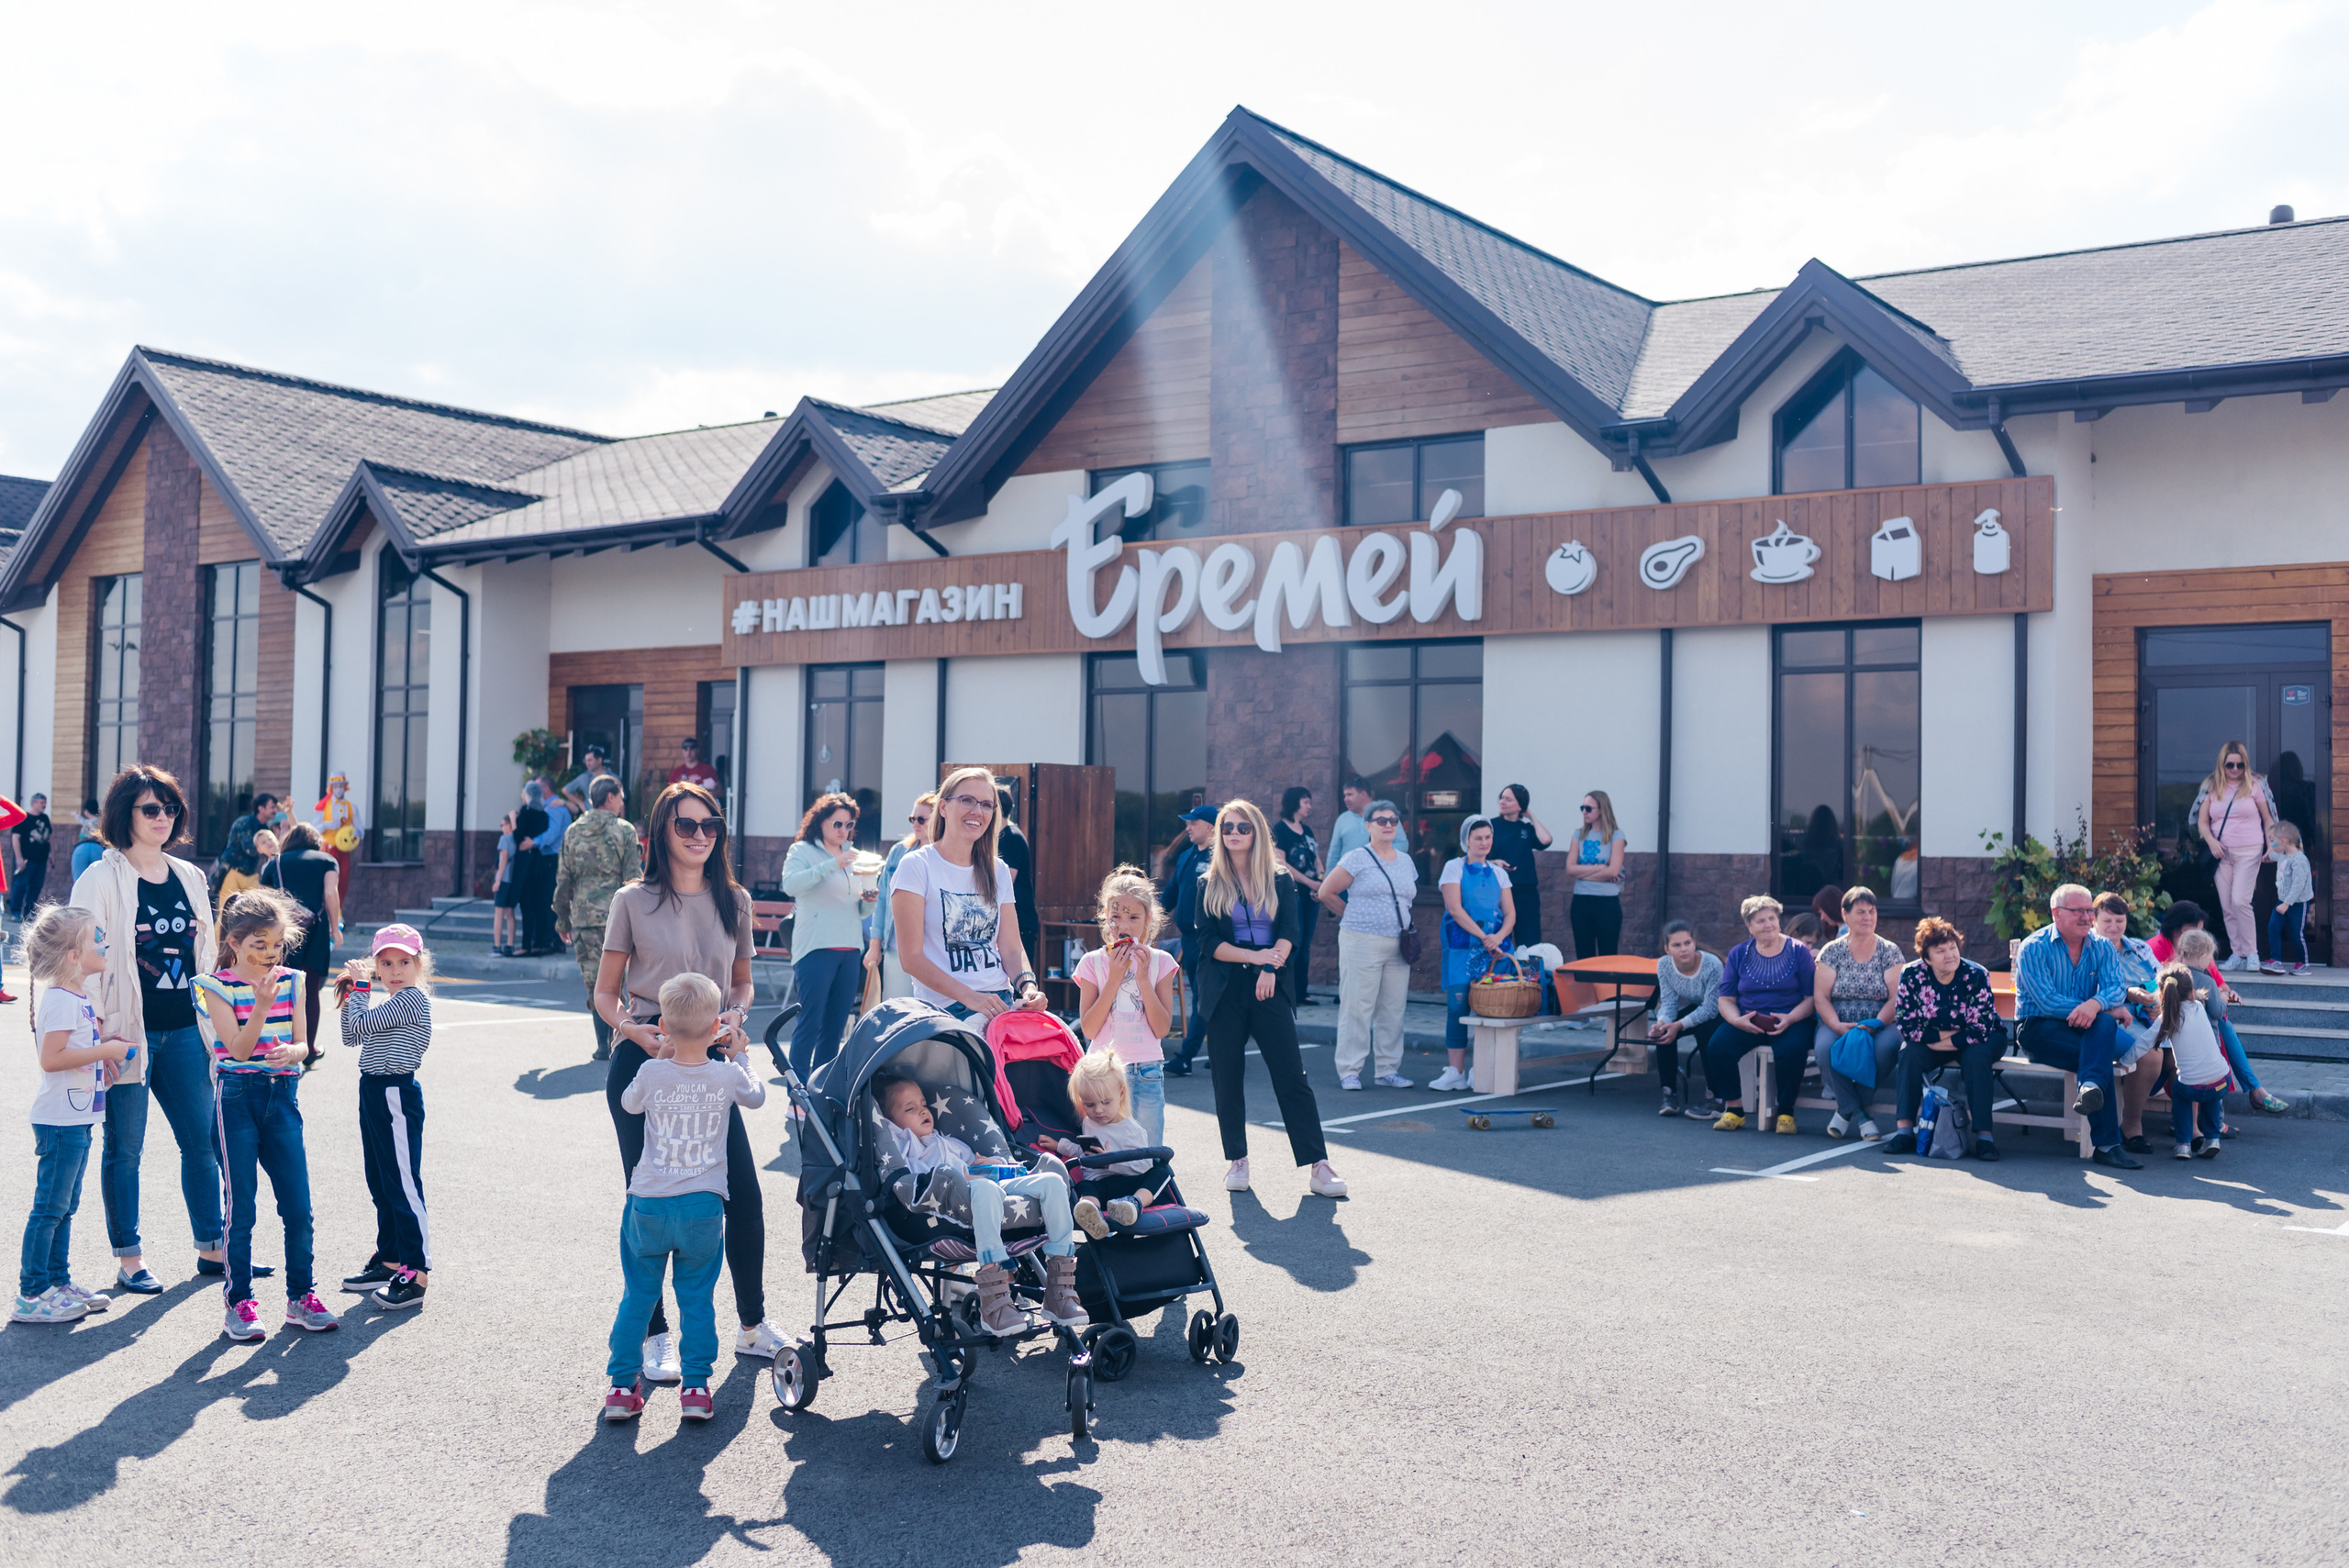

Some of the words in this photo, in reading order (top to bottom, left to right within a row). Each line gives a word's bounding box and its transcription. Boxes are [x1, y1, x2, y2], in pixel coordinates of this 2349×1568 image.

[1051, 472, 1484, 684] Еремей
[731, 583, 1023, 635] #НАШМАГАЗИН
[676, 1084, 690, 1093] YOU
[691, 1084, 707, 1093] CAN
[654, 1112, 721, 1140] WILD
[652, 1138, 716, 1167] SIDE
[668, 1167, 679, 1175] AM
